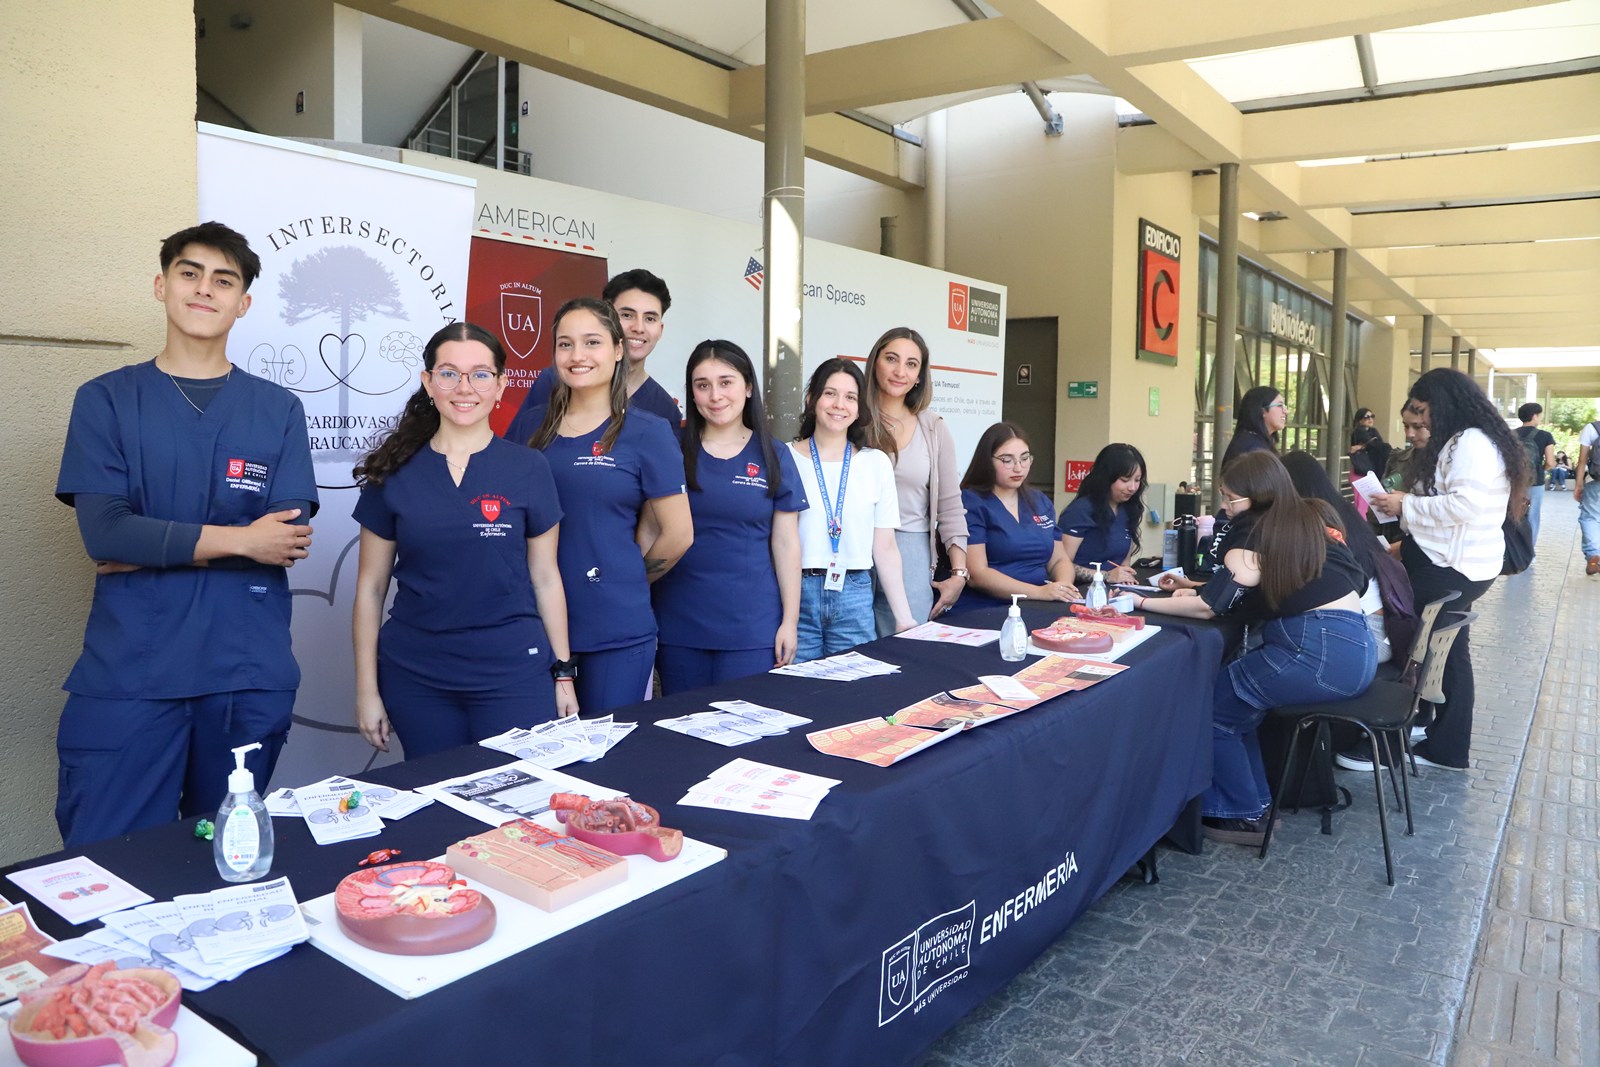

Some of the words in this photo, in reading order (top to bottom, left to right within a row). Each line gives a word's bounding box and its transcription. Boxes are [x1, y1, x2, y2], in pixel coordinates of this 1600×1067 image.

[478, 203, 595, 240] AMERICAN
[1145, 225, 1180, 258] EDIFICIO
[266, 216, 458, 326] INTERSECTORIA
[500, 283, 512, 291] DUC
[521, 283, 542, 295] ALTUM
[803, 284, 822, 299] can
[826, 284, 866, 306] Spaces
[971, 299, 999, 311] UNIVERSIDAD
[1152, 269, 1175, 341] C
[507, 313, 535, 332] UA
[953, 303, 963, 313] UA
[1271, 302, 1315, 346] Biblioteca
[505, 368, 527, 378] IDAD
[484, 504, 498, 512] UA
[980, 851, 1078, 945] ENFERMERÍA
[920, 919, 971, 954] UNIVERSIDAD
[891, 969, 906, 988] UA
[917, 965, 928, 980] DE
[935, 944, 966, 969] CHILE
[914, 1000, 927, 1015] MÁS
[927, 970, 969, 1004] UNIVERSIDAD
